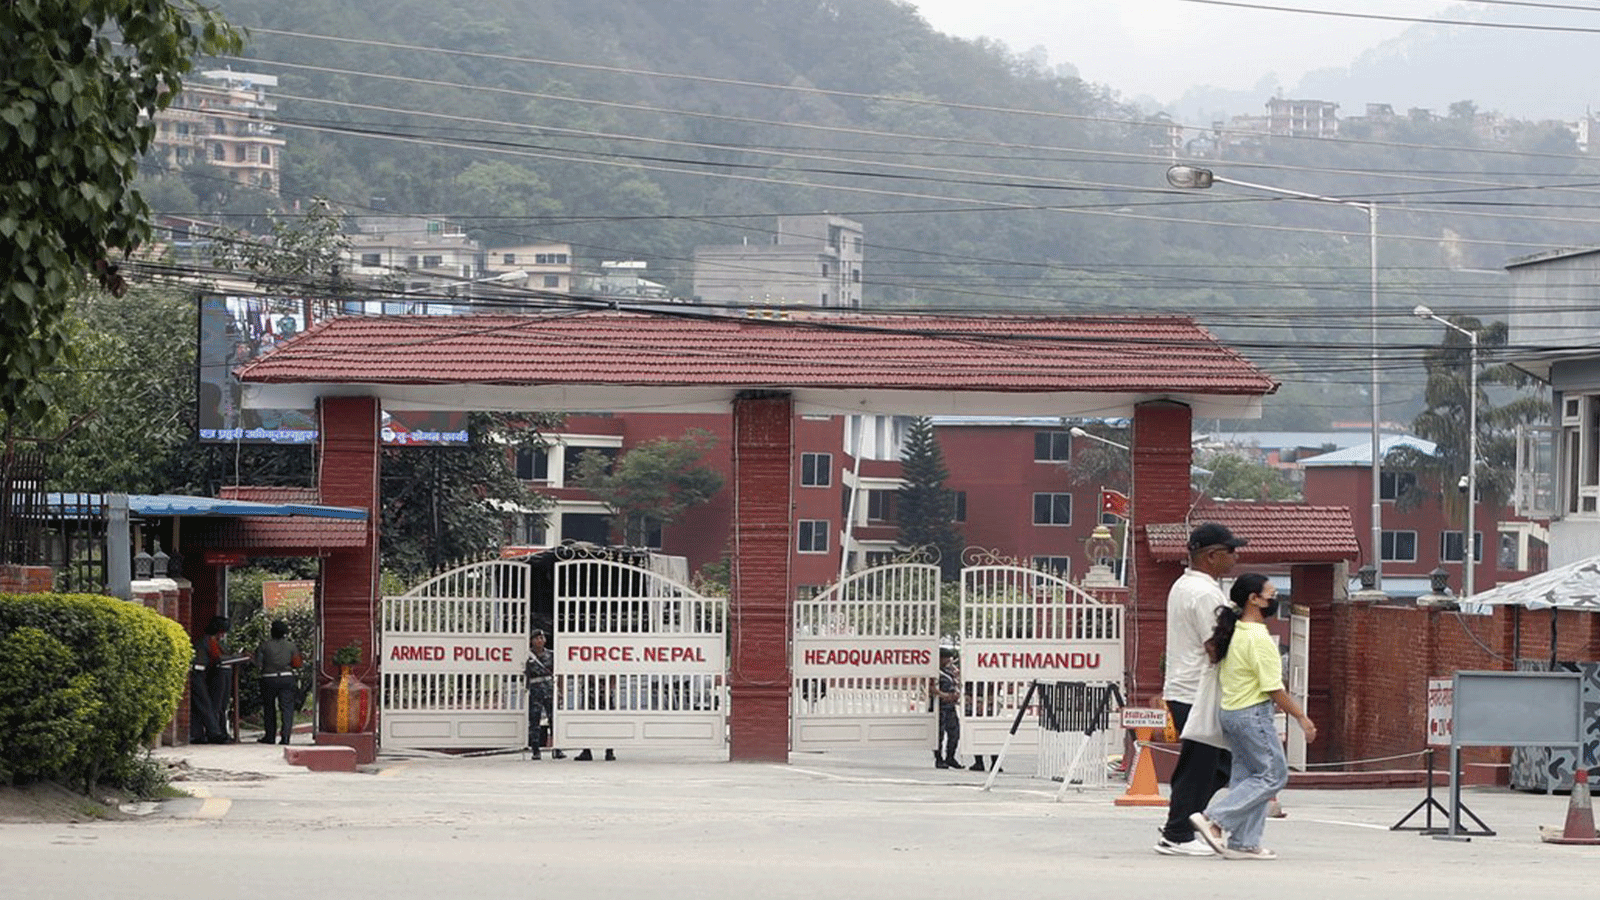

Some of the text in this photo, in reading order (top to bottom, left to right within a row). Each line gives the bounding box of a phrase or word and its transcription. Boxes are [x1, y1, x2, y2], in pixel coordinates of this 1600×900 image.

[390, 646, 513, 662] ARMED POLICE
[804, 649, 932, 667] HEADQUARTERS
[977, 652, 1100, 669] KATHMANDU
